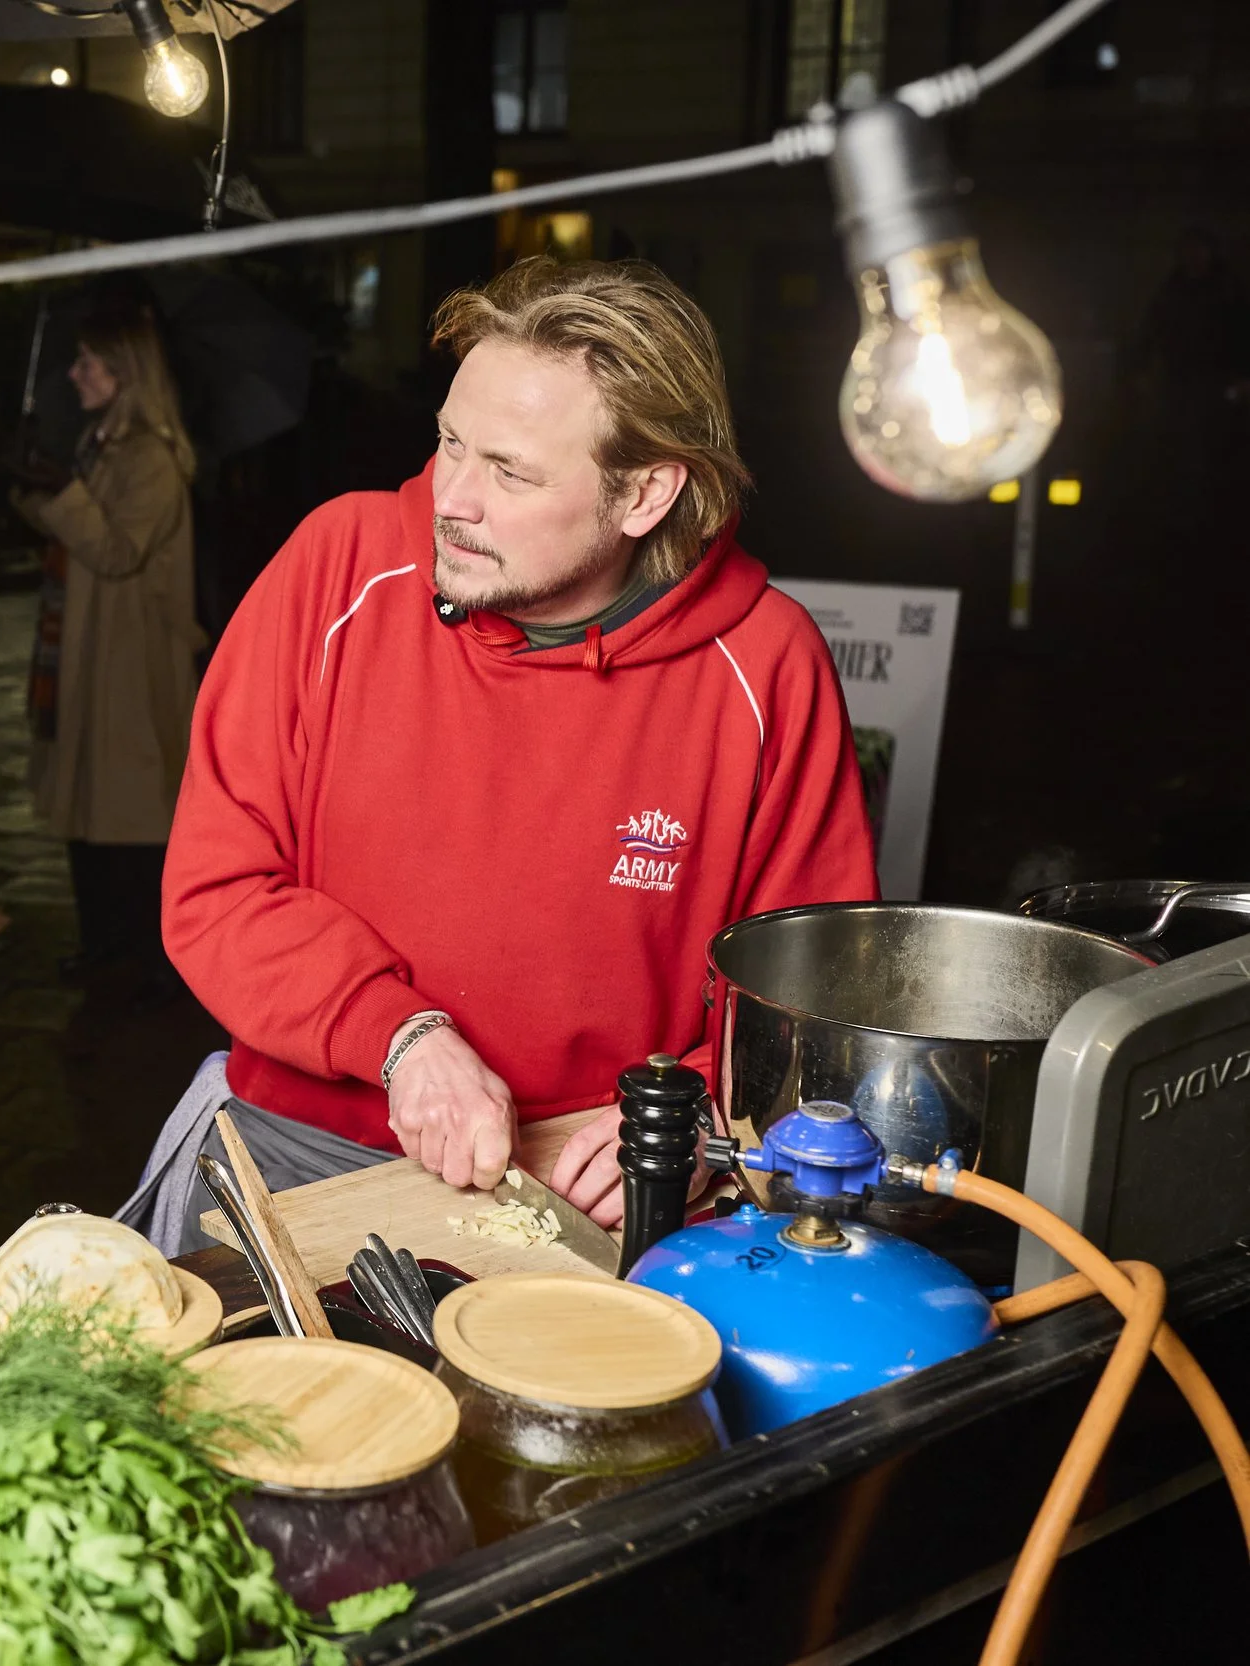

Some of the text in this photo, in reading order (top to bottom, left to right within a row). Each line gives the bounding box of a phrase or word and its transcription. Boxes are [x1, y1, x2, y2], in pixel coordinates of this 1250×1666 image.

[613, 855, 681, 882] ARMY
[609, 874, 675, 891] SPORTS LOTTERY
[736, 1246, 777, 1271] 20
